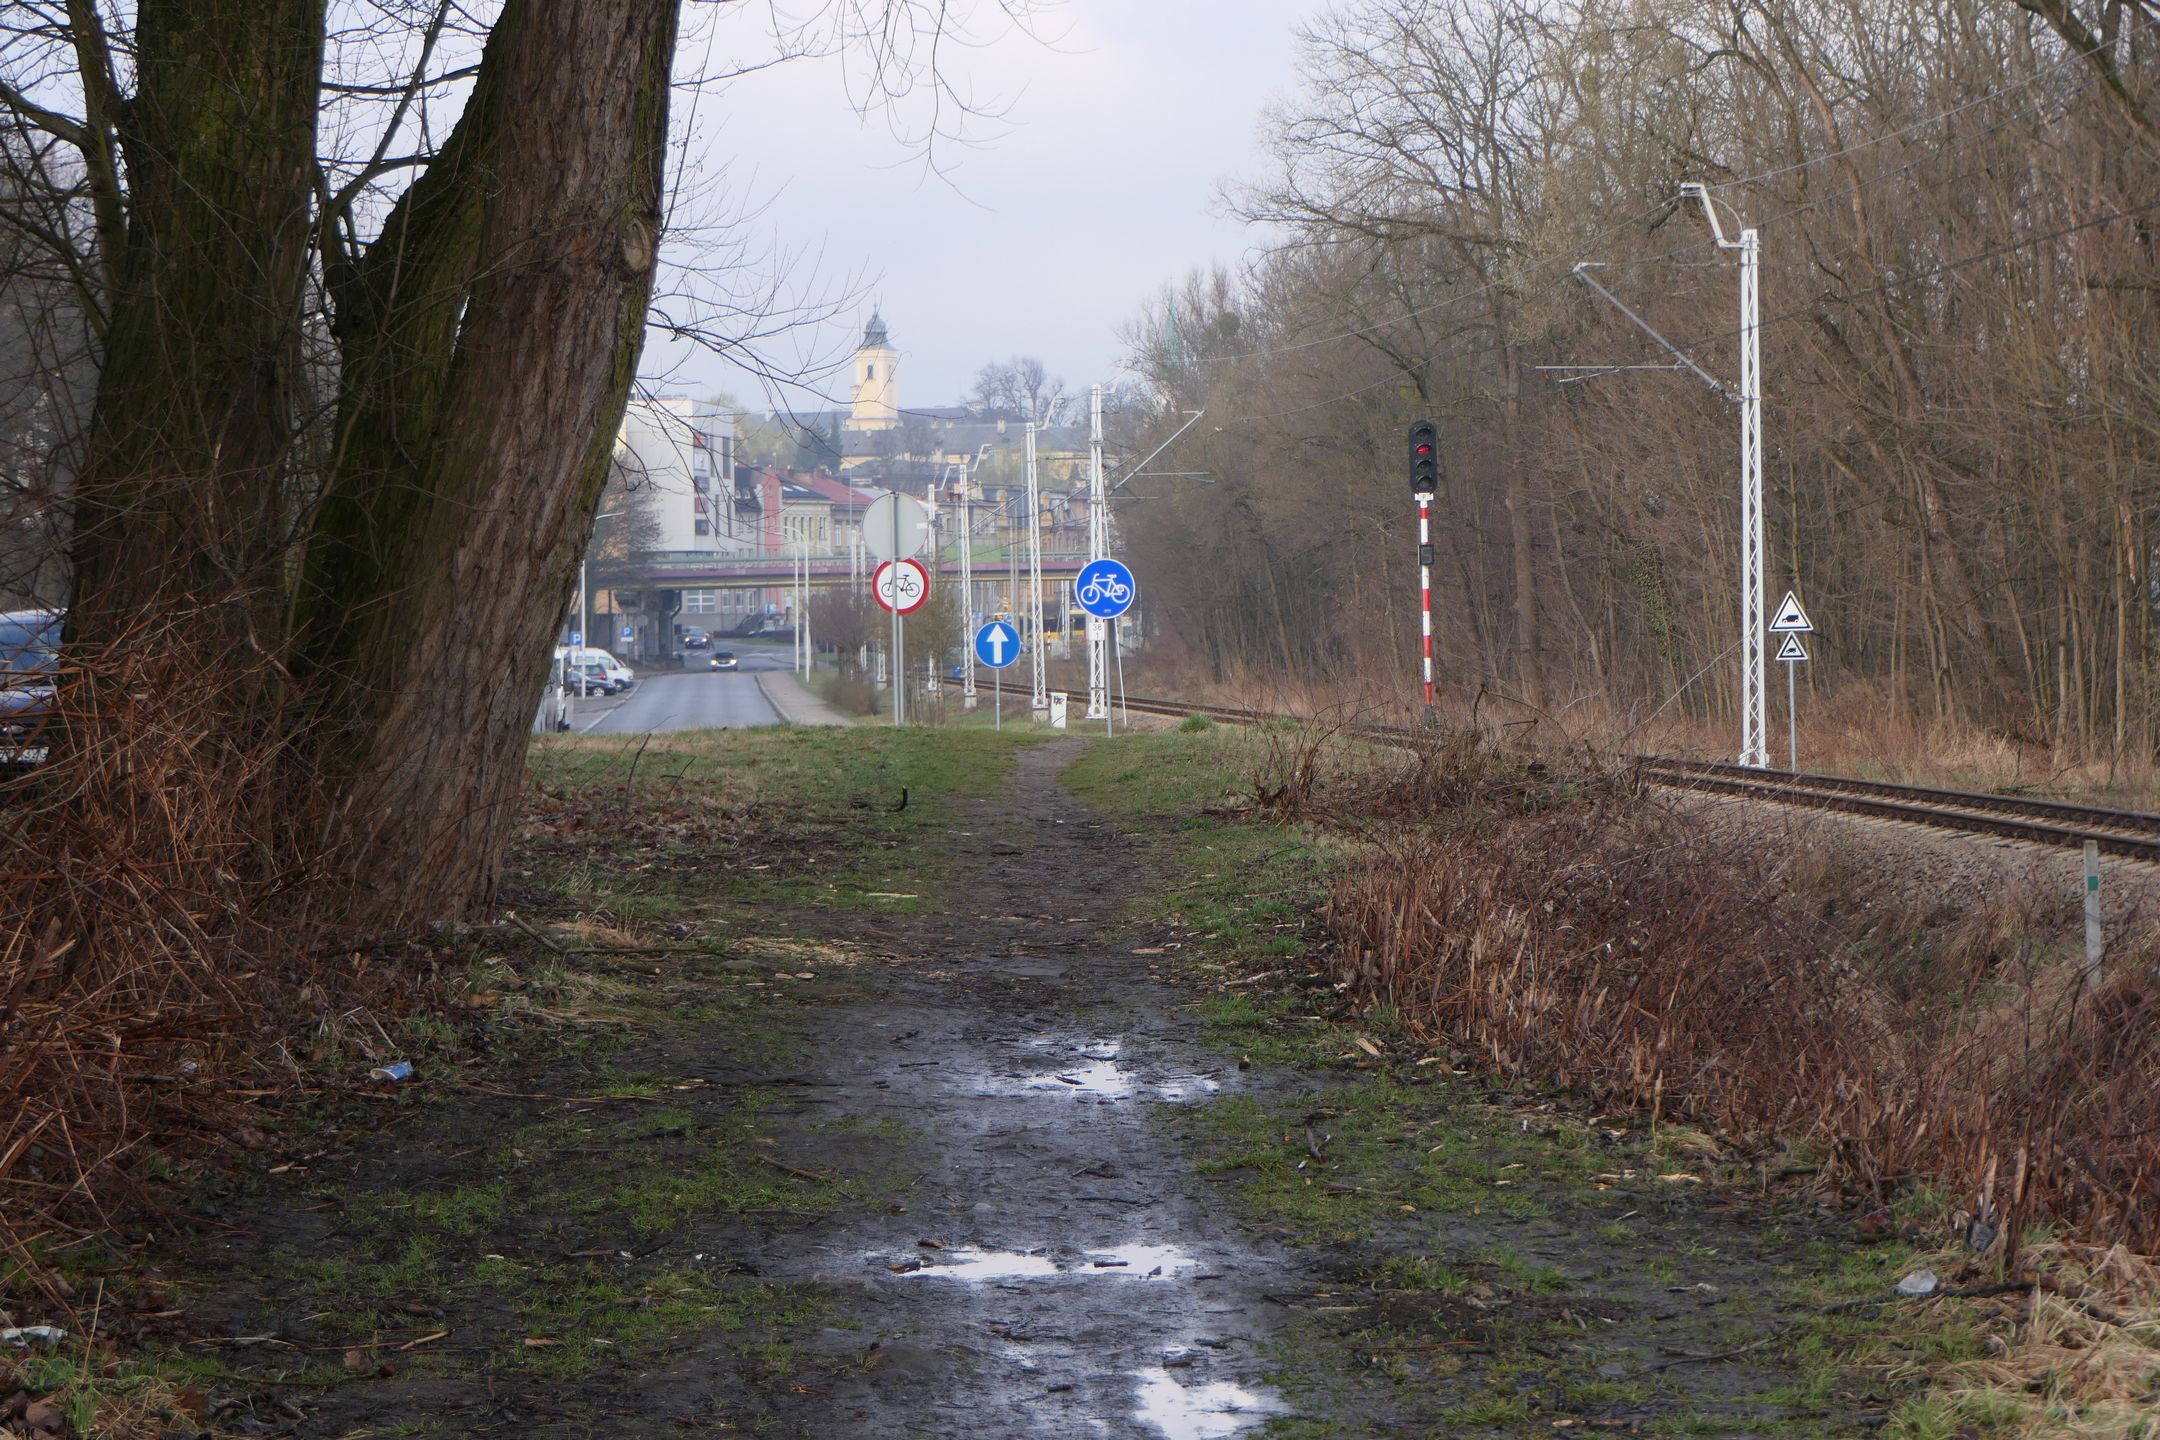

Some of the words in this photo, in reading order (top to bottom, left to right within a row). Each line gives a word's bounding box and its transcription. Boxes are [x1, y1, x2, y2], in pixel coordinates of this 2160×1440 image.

[624, 627, 631, 636] P
[1092, 623, 1103, 631] 38
[573, 634, 581, 644] P
